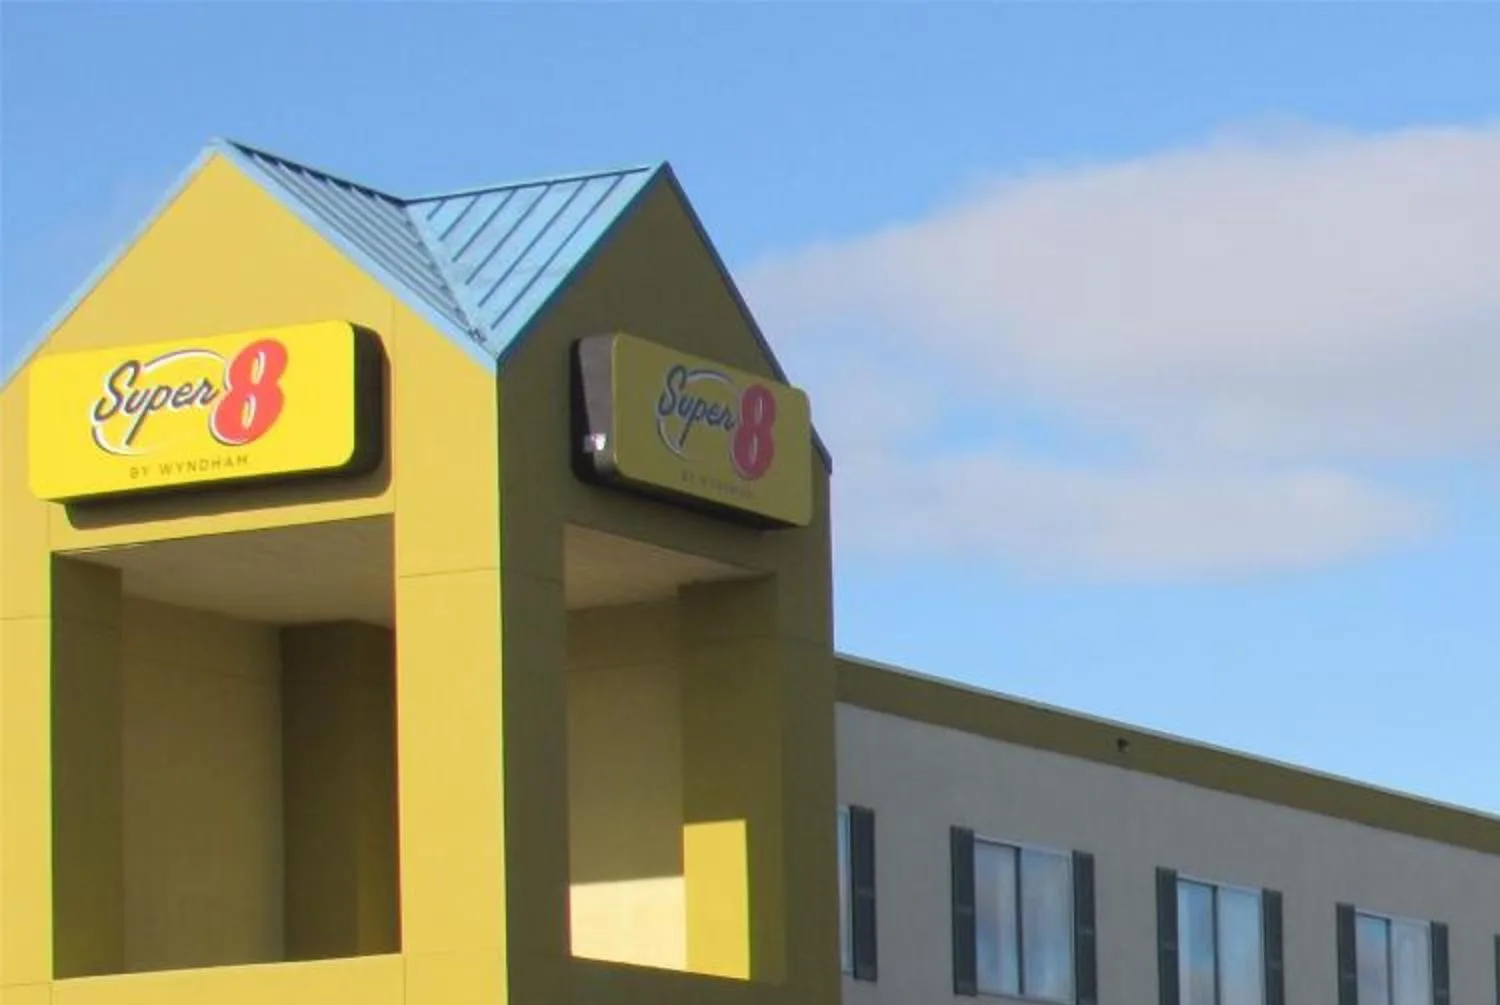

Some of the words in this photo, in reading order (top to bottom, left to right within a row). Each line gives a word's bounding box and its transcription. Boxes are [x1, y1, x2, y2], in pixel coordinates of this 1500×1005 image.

[92, 359, 219, 447] Super
[209, 338, 289, 446] 8
[657, 364, 736, 449] Super
[730, 384, 776, 481] 8
[129, 467, 150, 480] BY
[159, 454, 249, 476] WYNDHAM
